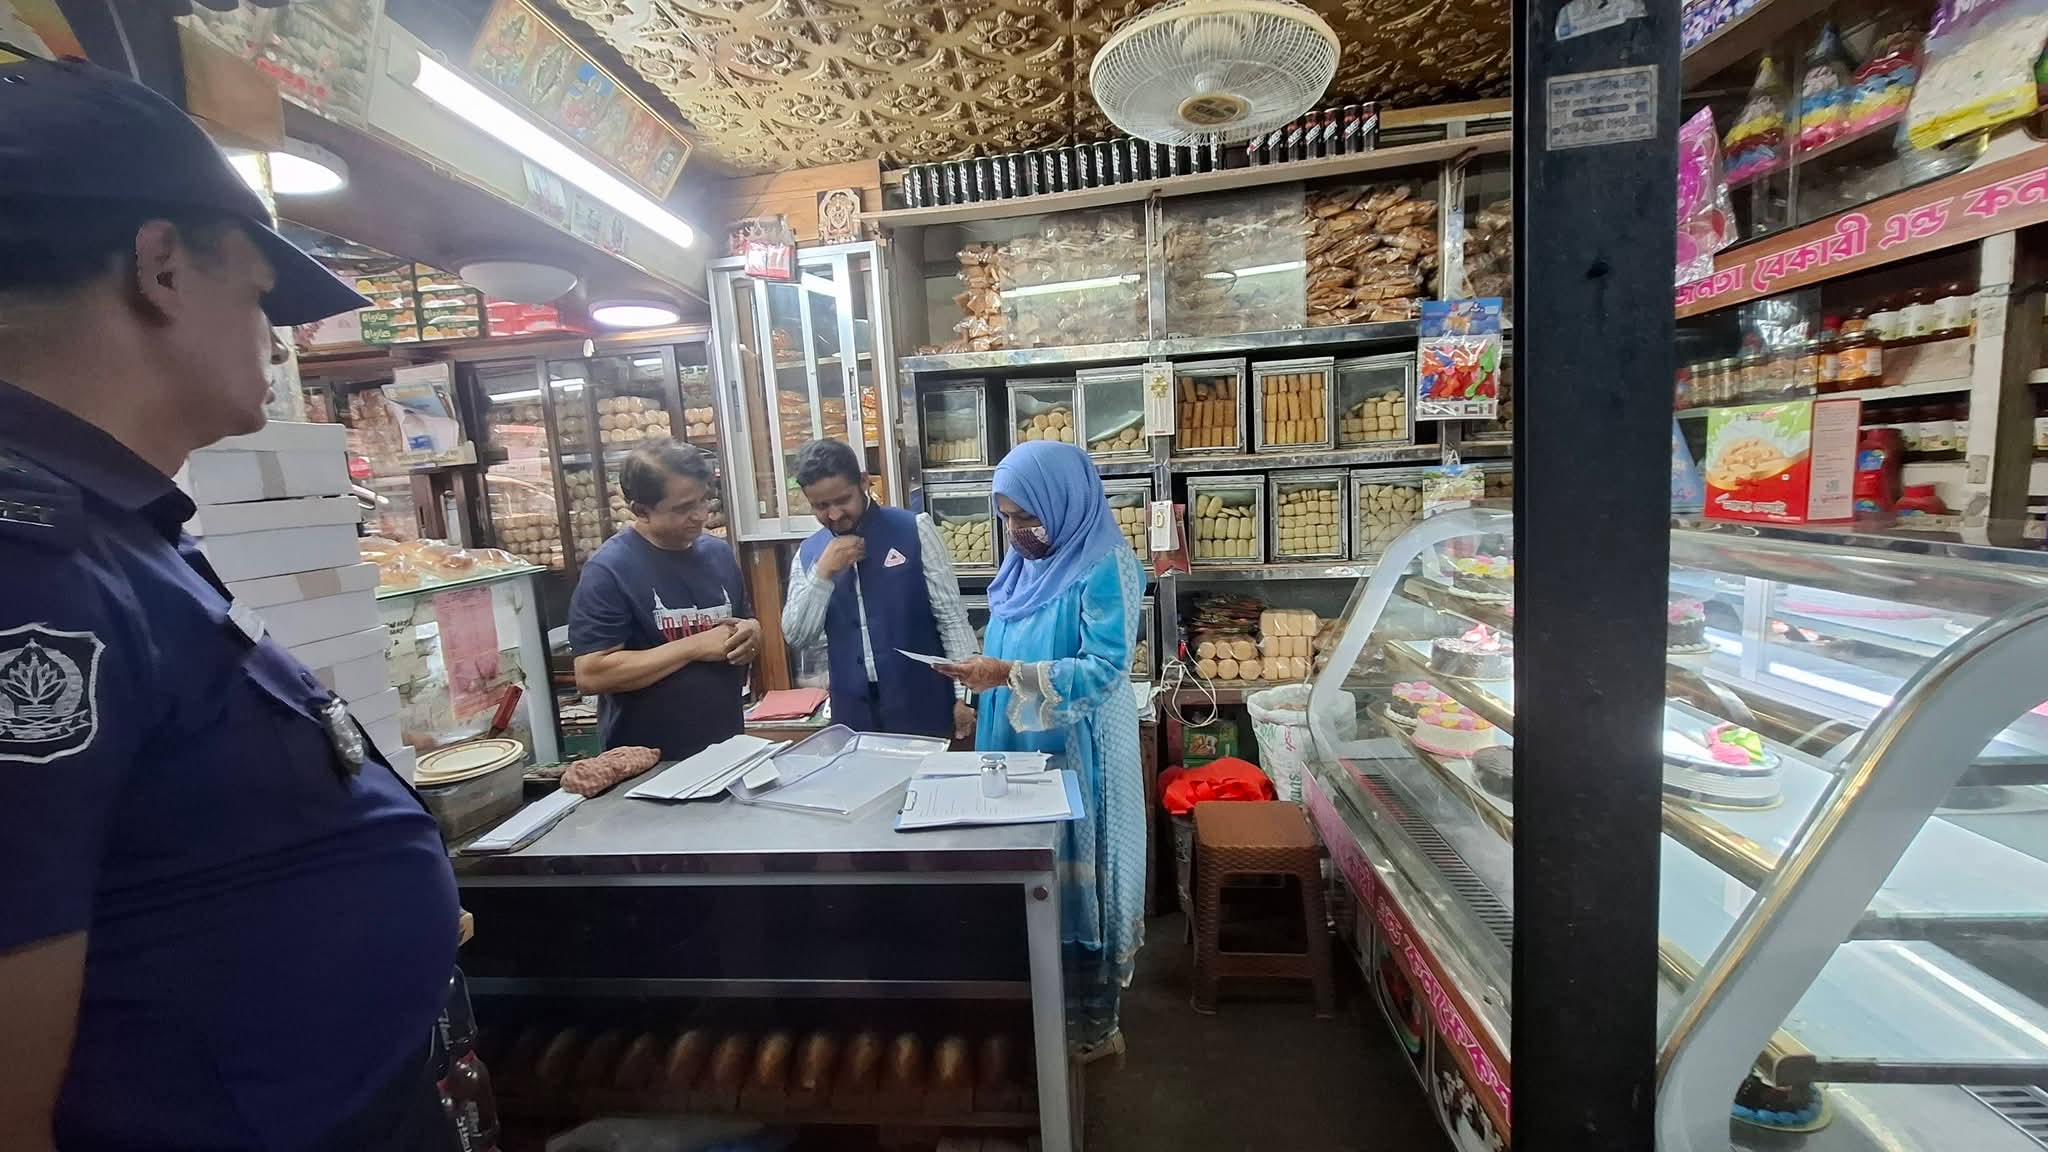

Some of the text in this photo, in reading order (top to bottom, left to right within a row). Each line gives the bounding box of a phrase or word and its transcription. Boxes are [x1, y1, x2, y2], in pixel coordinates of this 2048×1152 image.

[1675, 264, 1746, 306] জনতা
[1752, 213, 1872, 292] বেকারী
[1879, 197, 1954, 249] এন্ড
